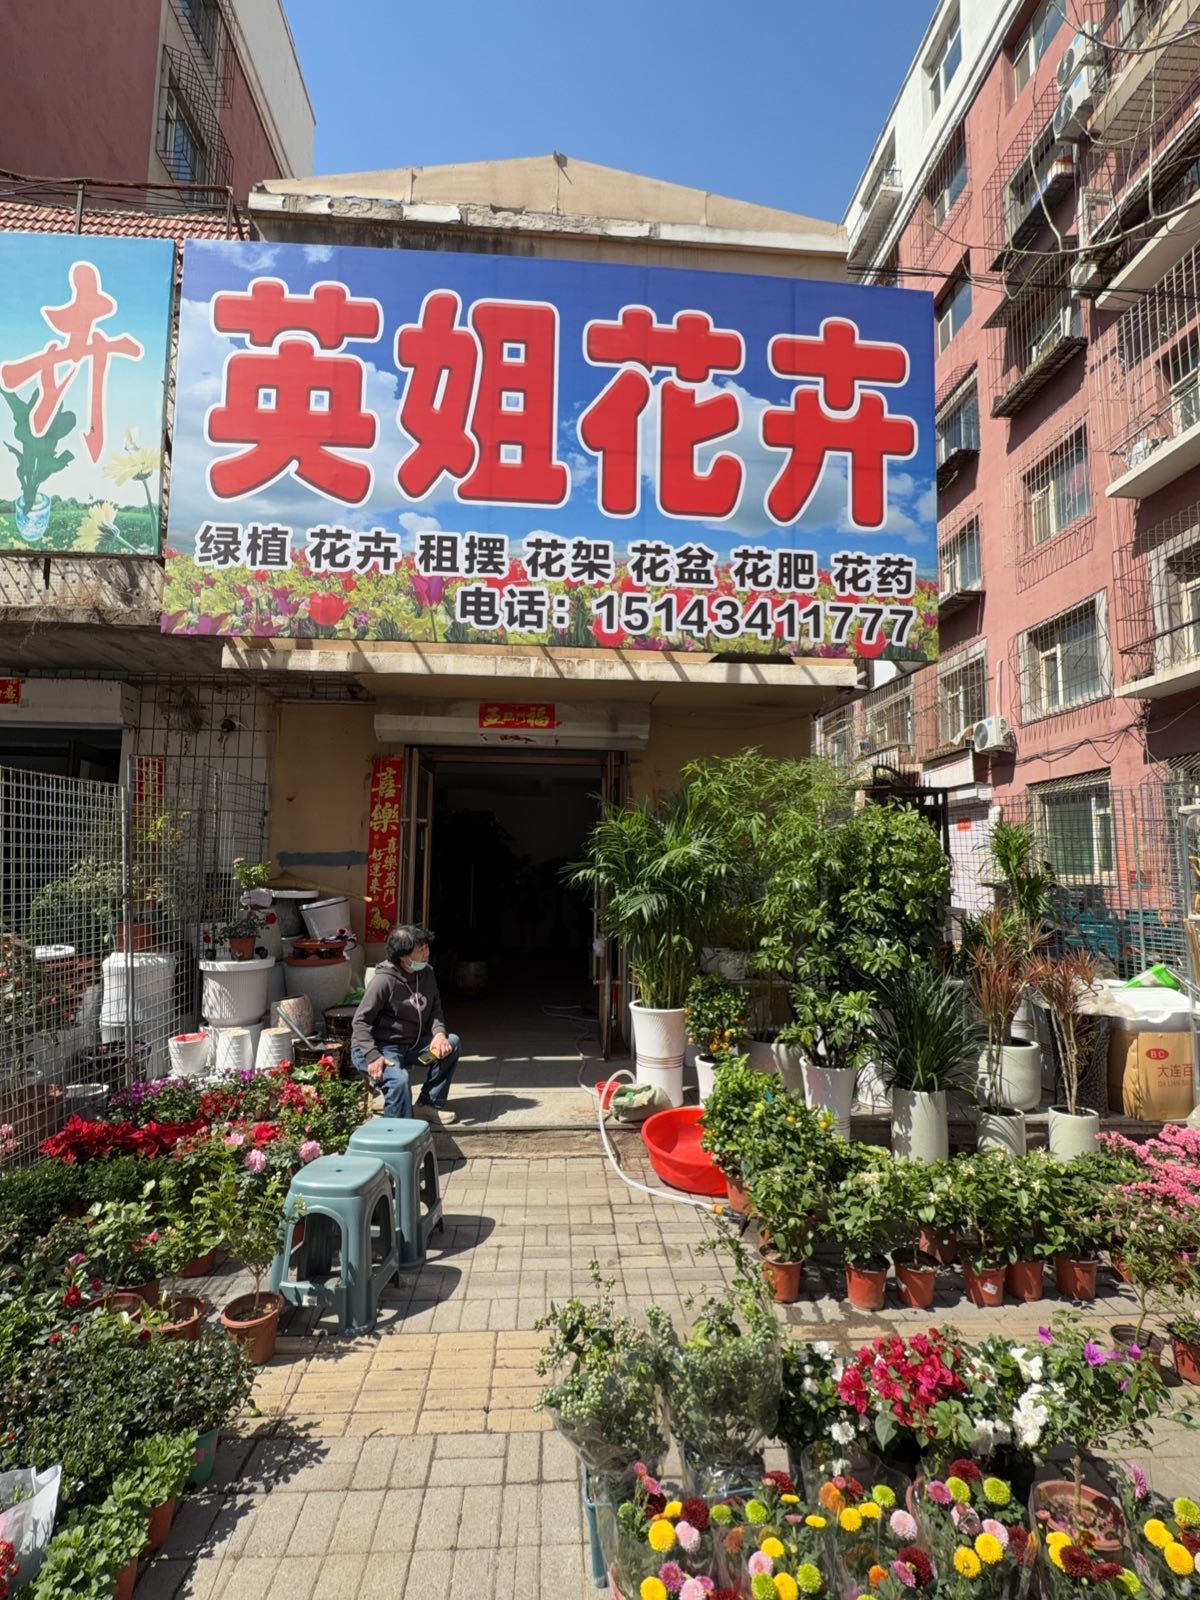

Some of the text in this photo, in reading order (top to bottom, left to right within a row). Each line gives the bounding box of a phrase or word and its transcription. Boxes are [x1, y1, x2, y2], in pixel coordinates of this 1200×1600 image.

[207, 277, 917, 530] 英姐花卉
[198, 524, 914, 596] 绿植 花卉 租摆 花架 花盆 花肥 花药
